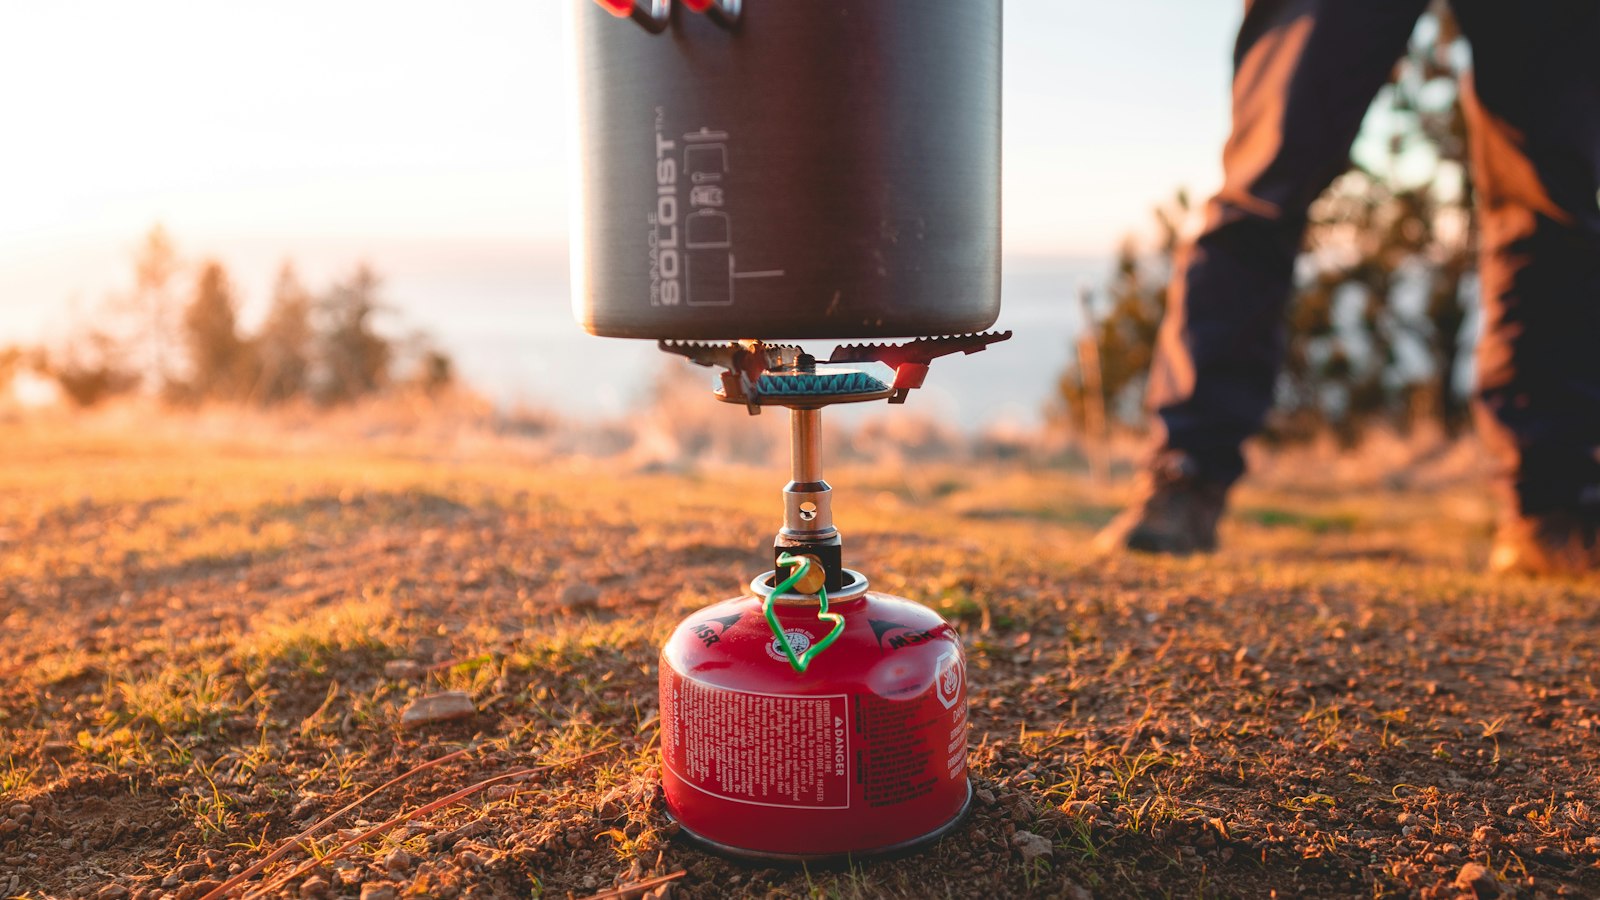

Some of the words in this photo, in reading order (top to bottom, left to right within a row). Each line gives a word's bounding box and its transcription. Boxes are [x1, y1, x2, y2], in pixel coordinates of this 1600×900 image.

[656, 132, 680, 307] SOLOIST
[648, 211, 660, 307] PINNACLE
[690, 623, 721, 648] MSR
[888, 629, 936, 651] MSR
[792, 734, 800, 746] only
[835, 729, 844, 776] DANGER
[741, 751, 746, 759] Do
[735, 784, 740, 793] Do
[747, 767, 755, 796] prolonged
